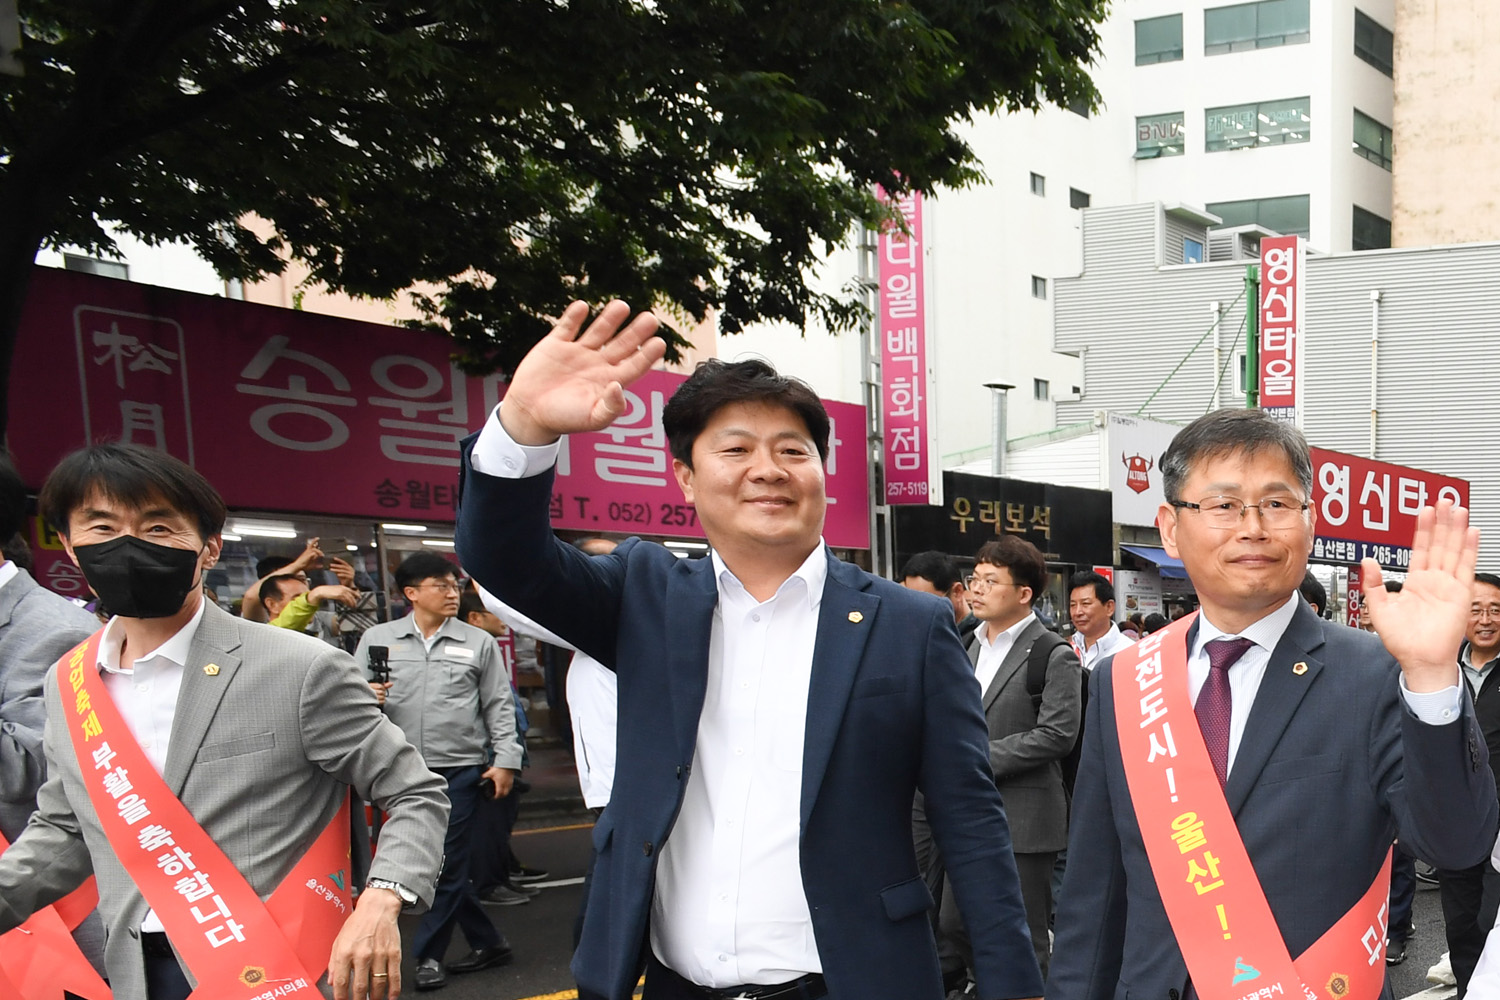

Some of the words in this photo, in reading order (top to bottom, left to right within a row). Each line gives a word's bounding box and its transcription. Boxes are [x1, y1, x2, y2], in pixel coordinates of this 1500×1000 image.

[1138, 119, 1182, 142] BNK
[1262, 247, 1296, 396] 영신타올
[887, 481, 928, 496] 257-5119
[608, 501, 652, 525] 052)
[951, 496, 1051, 541] 우리보석
[1314, 538, 1356, 561] 울산본점
[91, 740, 152, 826] 부활을
[136, 823, 247, 949] 축하합니다
[305, 878, 346, 914] 울산광역시
